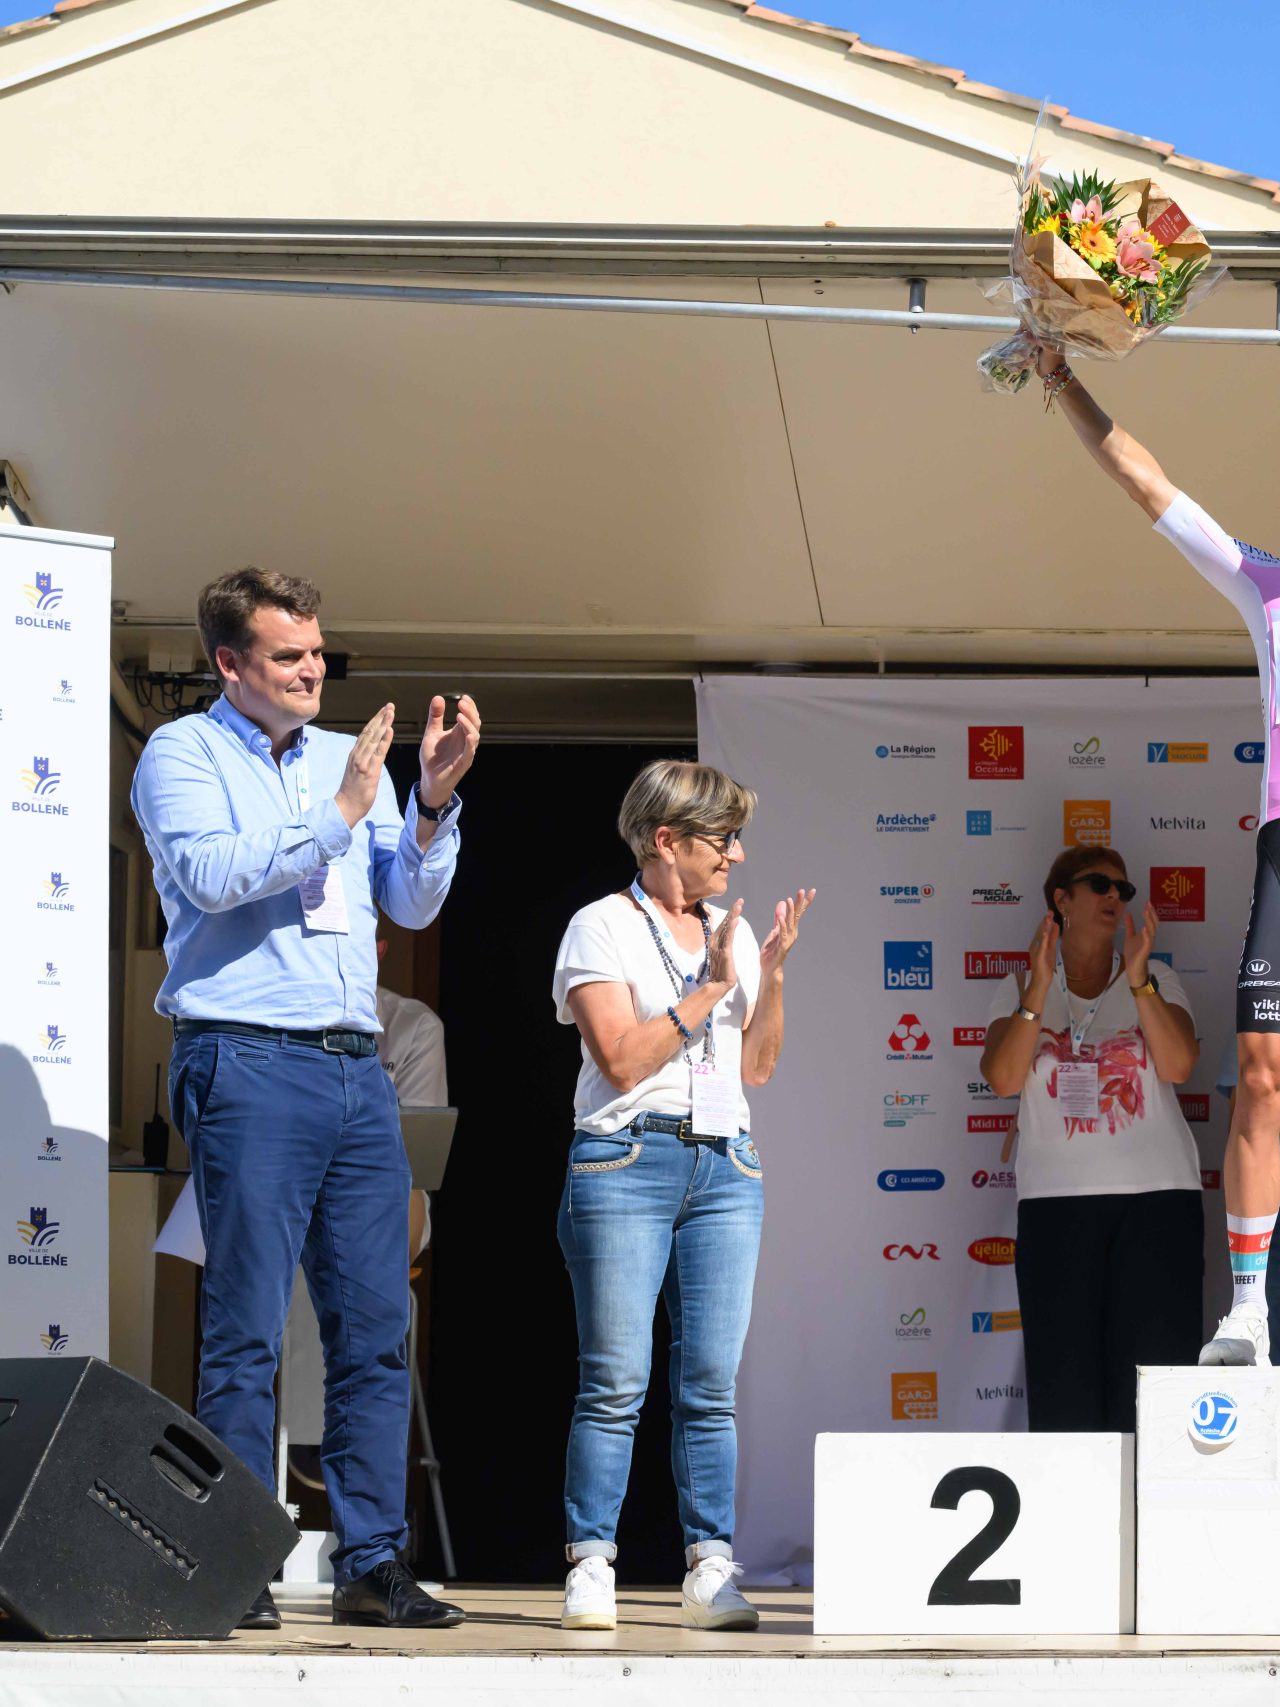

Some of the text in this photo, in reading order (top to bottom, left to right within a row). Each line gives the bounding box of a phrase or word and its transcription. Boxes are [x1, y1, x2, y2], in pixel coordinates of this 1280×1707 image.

[890, 745, 936, 755] La Région
[1068, 755, 1106, 765] lozère
[975, 765, 1018, 773] Occitanie
[876, 813, 930, 825] Ardèche
[1070, 817, 1106, 828] GARD
[1150, 816, 1206, 830] Melvita
[880, 886, 919, 896] SUPER
[968, 953, 1027, 976] La Tribune
[887, 967, 930, 987] bleu
[960, 1030, 974, 1041] LE
[971, 1118, 996, 1129] Midi
[989, 1171, 1015, 1182] AES
[895, 1326, 932, 1337] lozère
[897, 1390, 932, 1401] GARD
[976, 1384, 1024, 1400] Melvita
[927, 1466, 1021, 1606] 2
